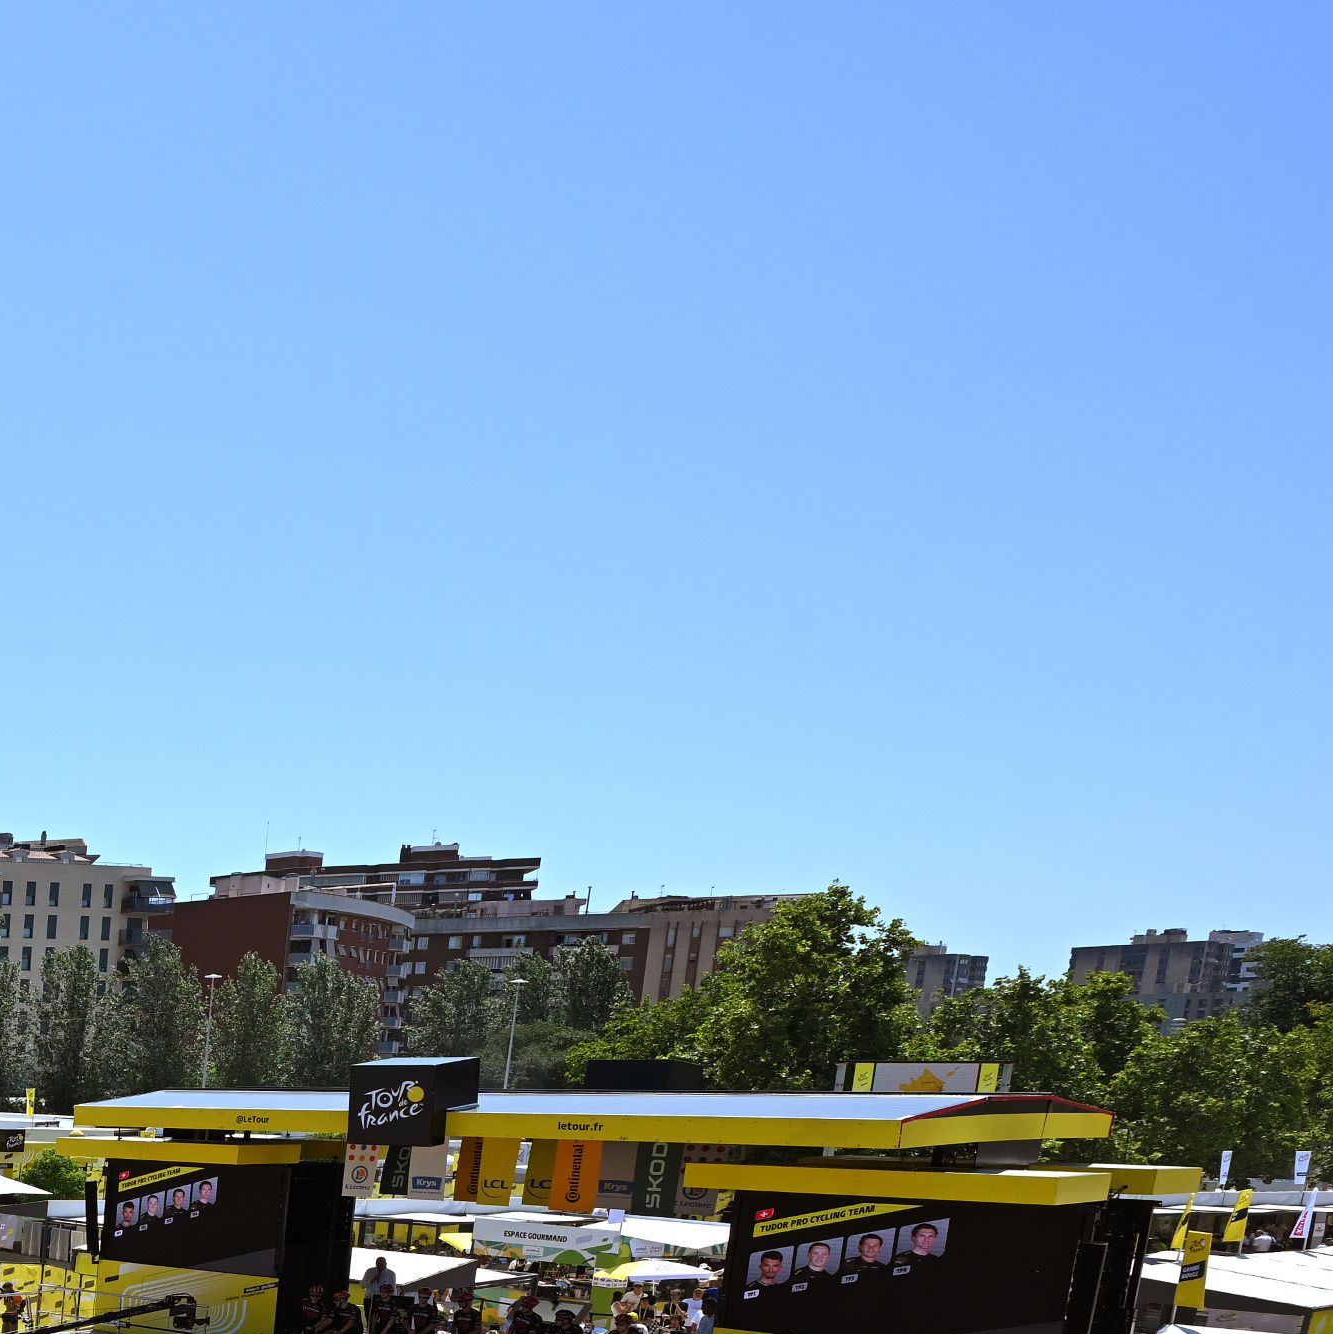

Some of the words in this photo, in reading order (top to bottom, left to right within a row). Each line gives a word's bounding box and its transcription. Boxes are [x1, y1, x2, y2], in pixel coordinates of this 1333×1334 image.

[236, 1115, 270, 1124] @LeTour
[558, 1121, 604, 1133] letour.fr
[565, 1145, 584, 1203] Continental
[645, 1142, 669, 1209] ŠKOD
[416, 1178, 437, 1189] Krys
[484, 1179, 508, 1190] LCL
[530, 1178, 552, 1190] LC
[603, 1182, 628, 1193] Krys
[760, 1221, 789, 1233] TUDOR
[790, 1217, 809, 1227] PRO
[810, 1210, 847, 1224] CYCLING
[848, 1204, 876, 1217] TEAM
[503, 1230, 526, 1240] ESPACE
[527, 1232, 568, 1243] GOURMAND
